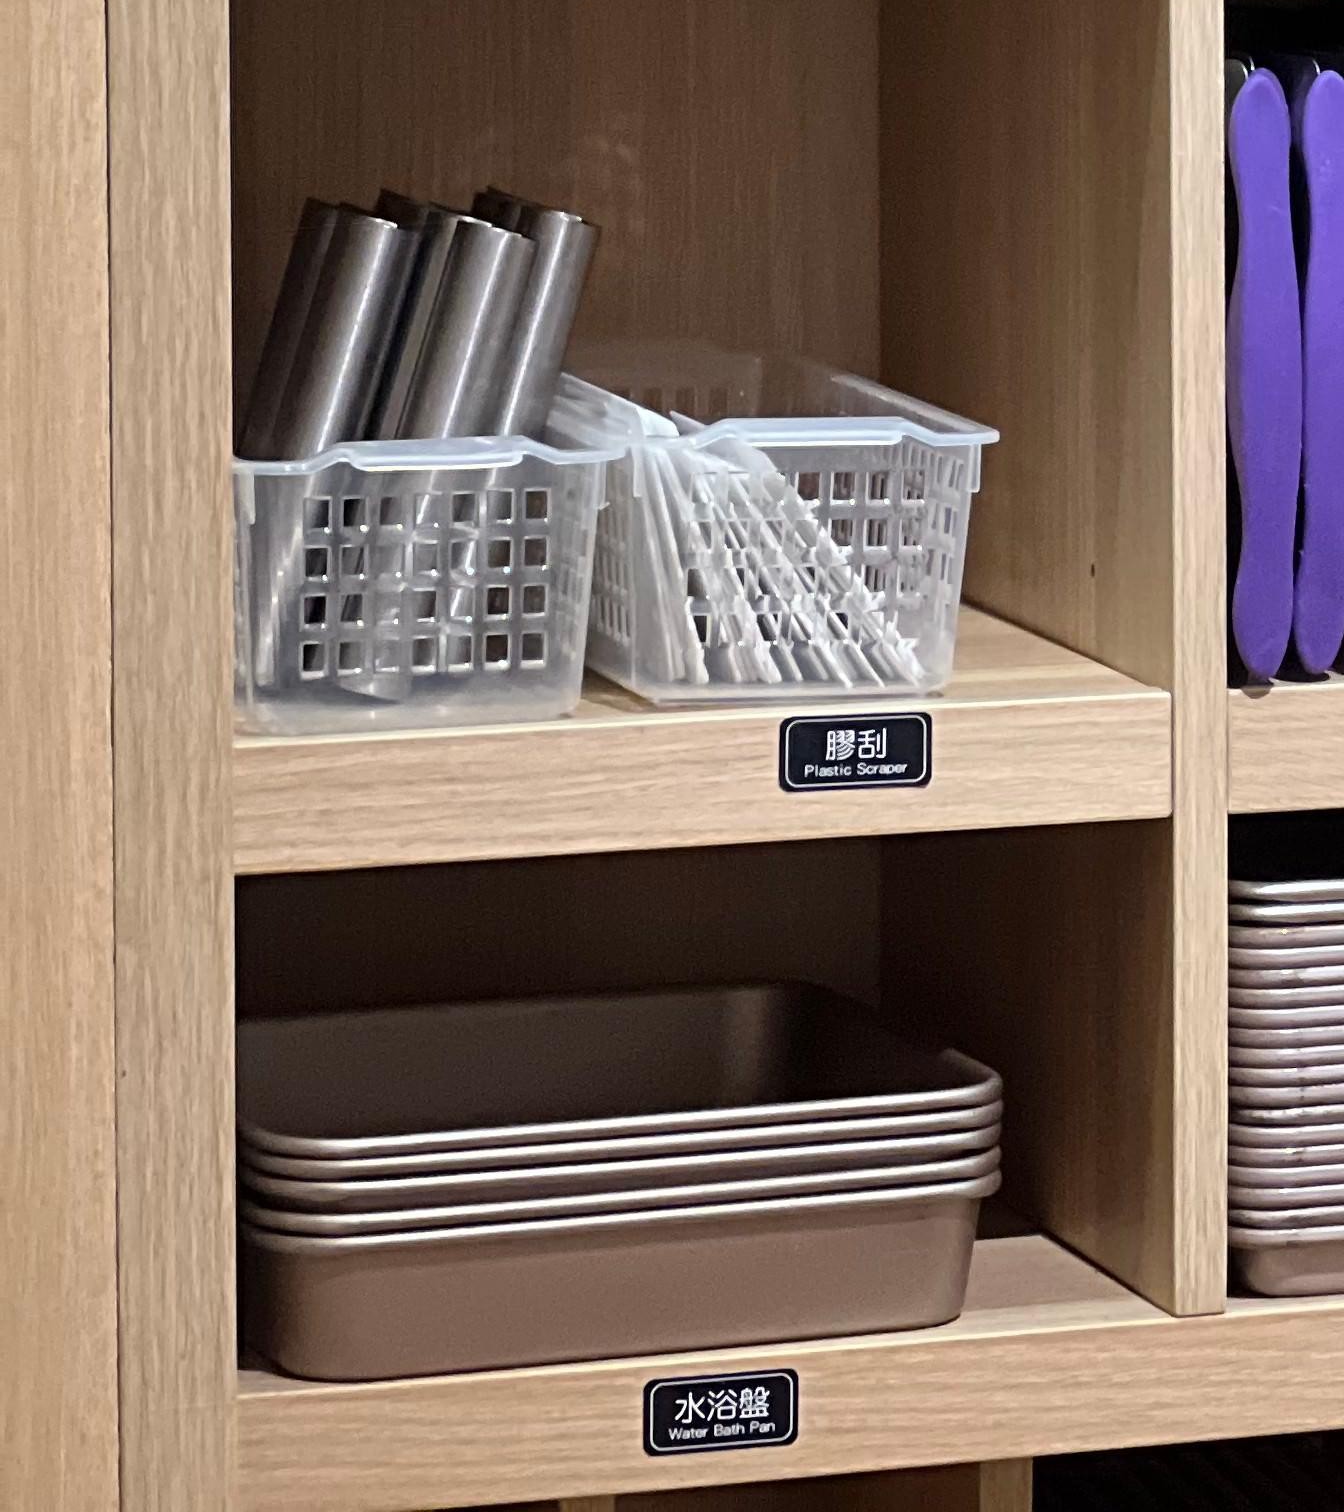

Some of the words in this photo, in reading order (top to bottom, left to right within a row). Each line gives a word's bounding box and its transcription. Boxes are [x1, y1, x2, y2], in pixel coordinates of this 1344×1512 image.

[825, 727, 887, 761] 膠刮
[804, 764, 851, 778] Plastic
[857, 762, 907, 775] Scraper
[674, 1386, 770, 1424] 水浴盤
[668, 1427, 709, 1441] Water
[714, 1423, 745, 1437] Bath
[750, 1421, 776, 1434] Pan
